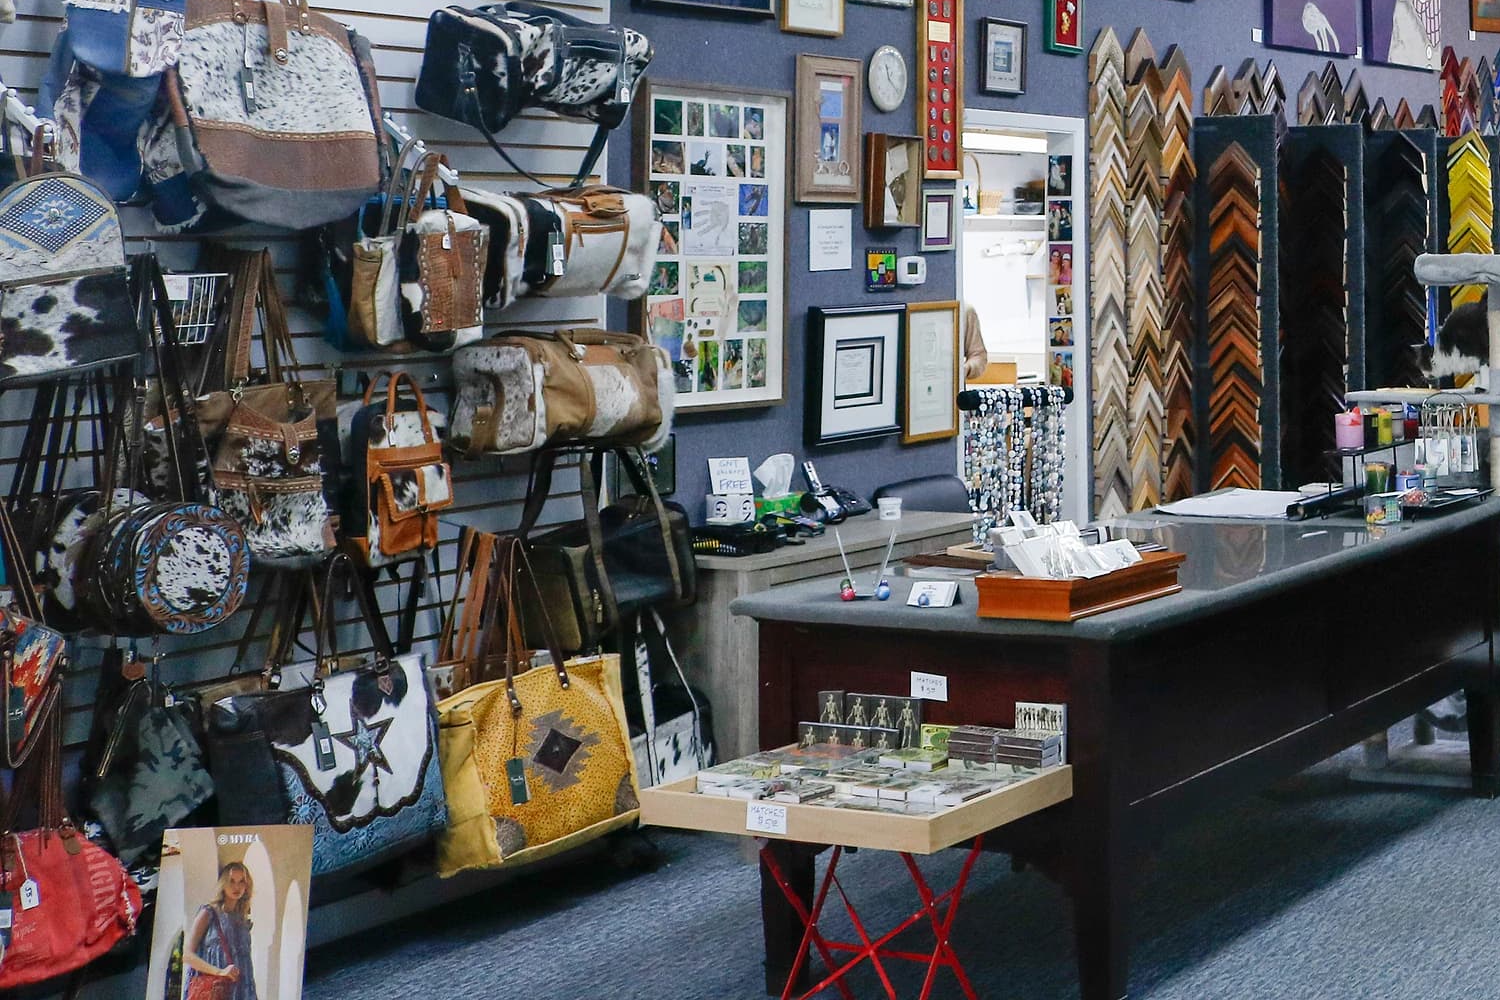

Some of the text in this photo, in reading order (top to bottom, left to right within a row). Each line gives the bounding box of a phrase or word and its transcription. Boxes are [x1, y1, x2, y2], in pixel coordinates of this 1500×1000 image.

[719, 478, 749, 490] FREE
[750, 805, 785, 818] MATCHES
[229, 834, 260, 844] MYRA
